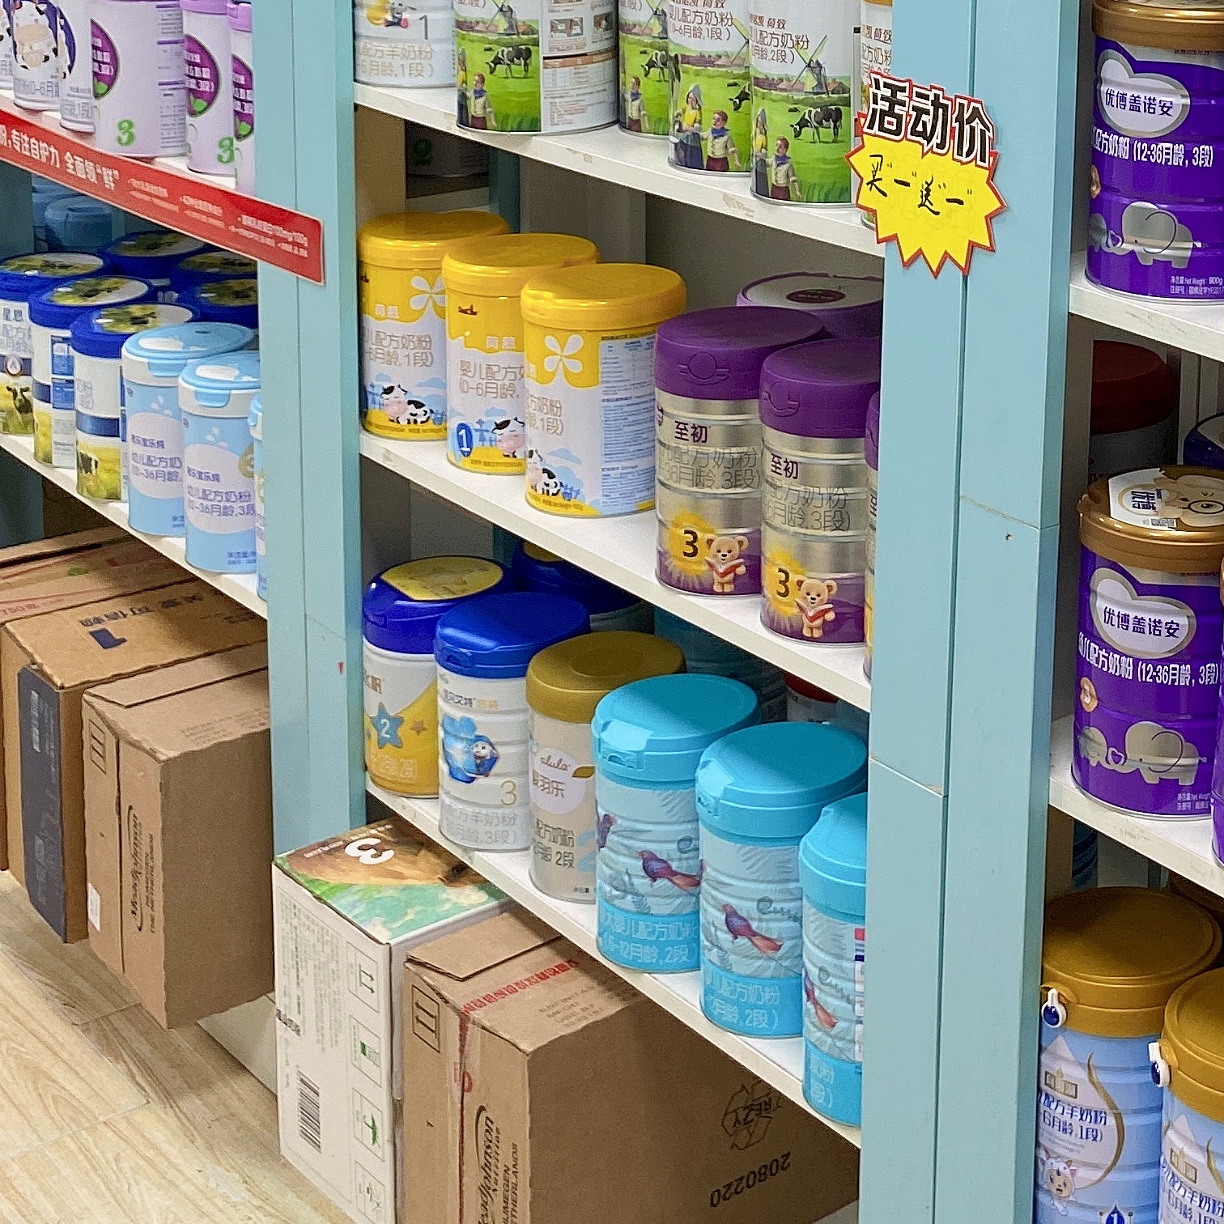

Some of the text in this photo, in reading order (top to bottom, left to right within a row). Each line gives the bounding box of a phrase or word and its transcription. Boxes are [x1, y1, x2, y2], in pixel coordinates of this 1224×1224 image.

[418, 14, 429, 40] 1
[1105, 87, 1174, 117] 优博盖诺安
[117, 119, 136, 146] 3
[866, 76, 992, 165] 活动价
[458, 427, 472, 453] 1
[674, 419, 709, 444] 至初
[770, 453, 799, 480] 至初
[682, 528, 699, 559] 3
[776, 567, 791, 599] 3
[1102, 605, 1180, 638] 优博盖诺安
[380, 718, 391, 739] 2
[500, 780, 517, 806] 3
[709, 1151, 791, 1208] 2080220
